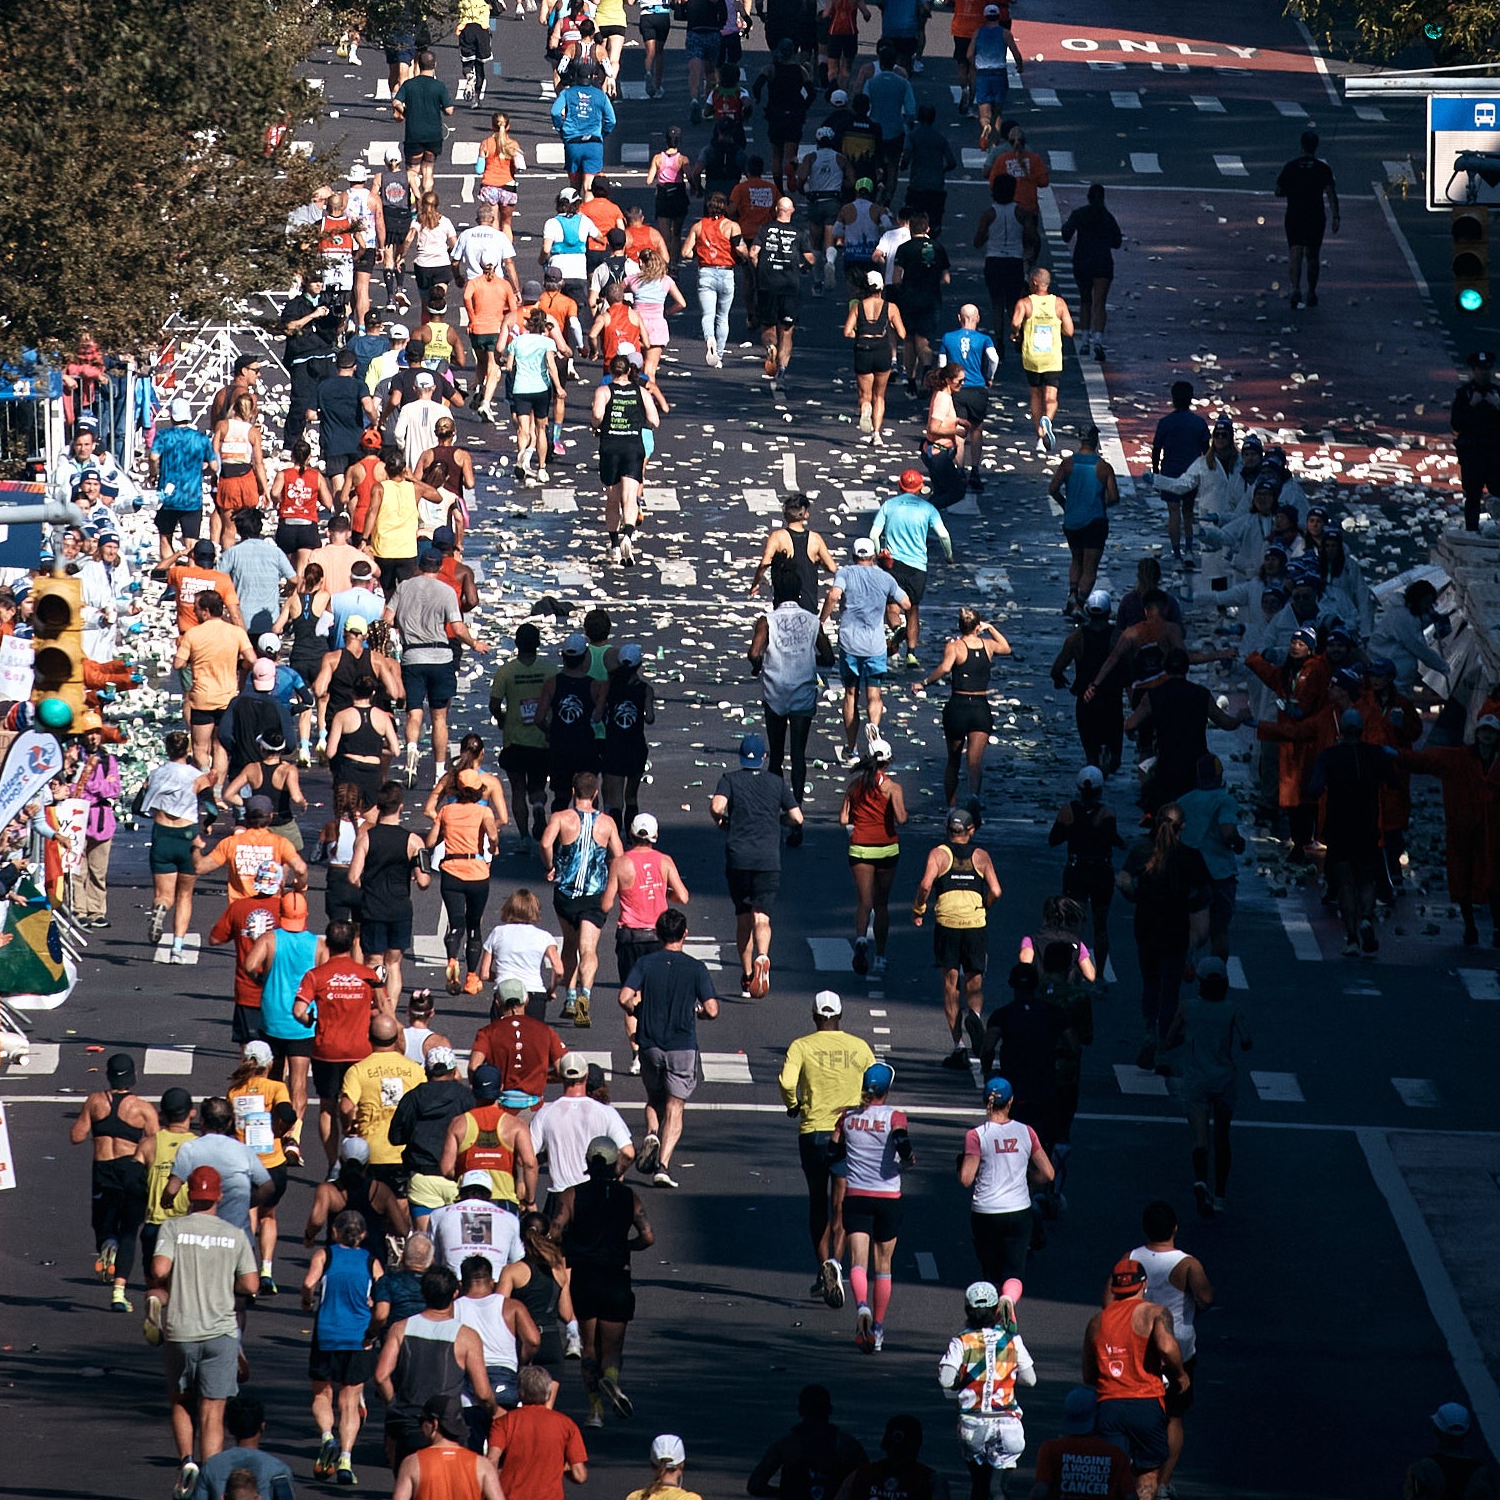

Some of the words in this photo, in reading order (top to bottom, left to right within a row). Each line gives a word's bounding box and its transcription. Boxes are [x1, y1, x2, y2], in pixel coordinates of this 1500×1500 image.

[1061, 38, 1259, 60] ONLY
[776, 613, 807, 631] KEEP
[814, 1049, 862, 1071] TFK
[847, 1117, 886, 1133] JULIE
[994, 1138, 1019, 1154] LIZ
[1063, 1454, 1112, 1466] IMAGINE
[1072, 1465, 1111, 1476] WORLD
[1062, 1474, 1110, 1484] WITHOUT
[1061, 1482, 1109, 1495] CANCER
